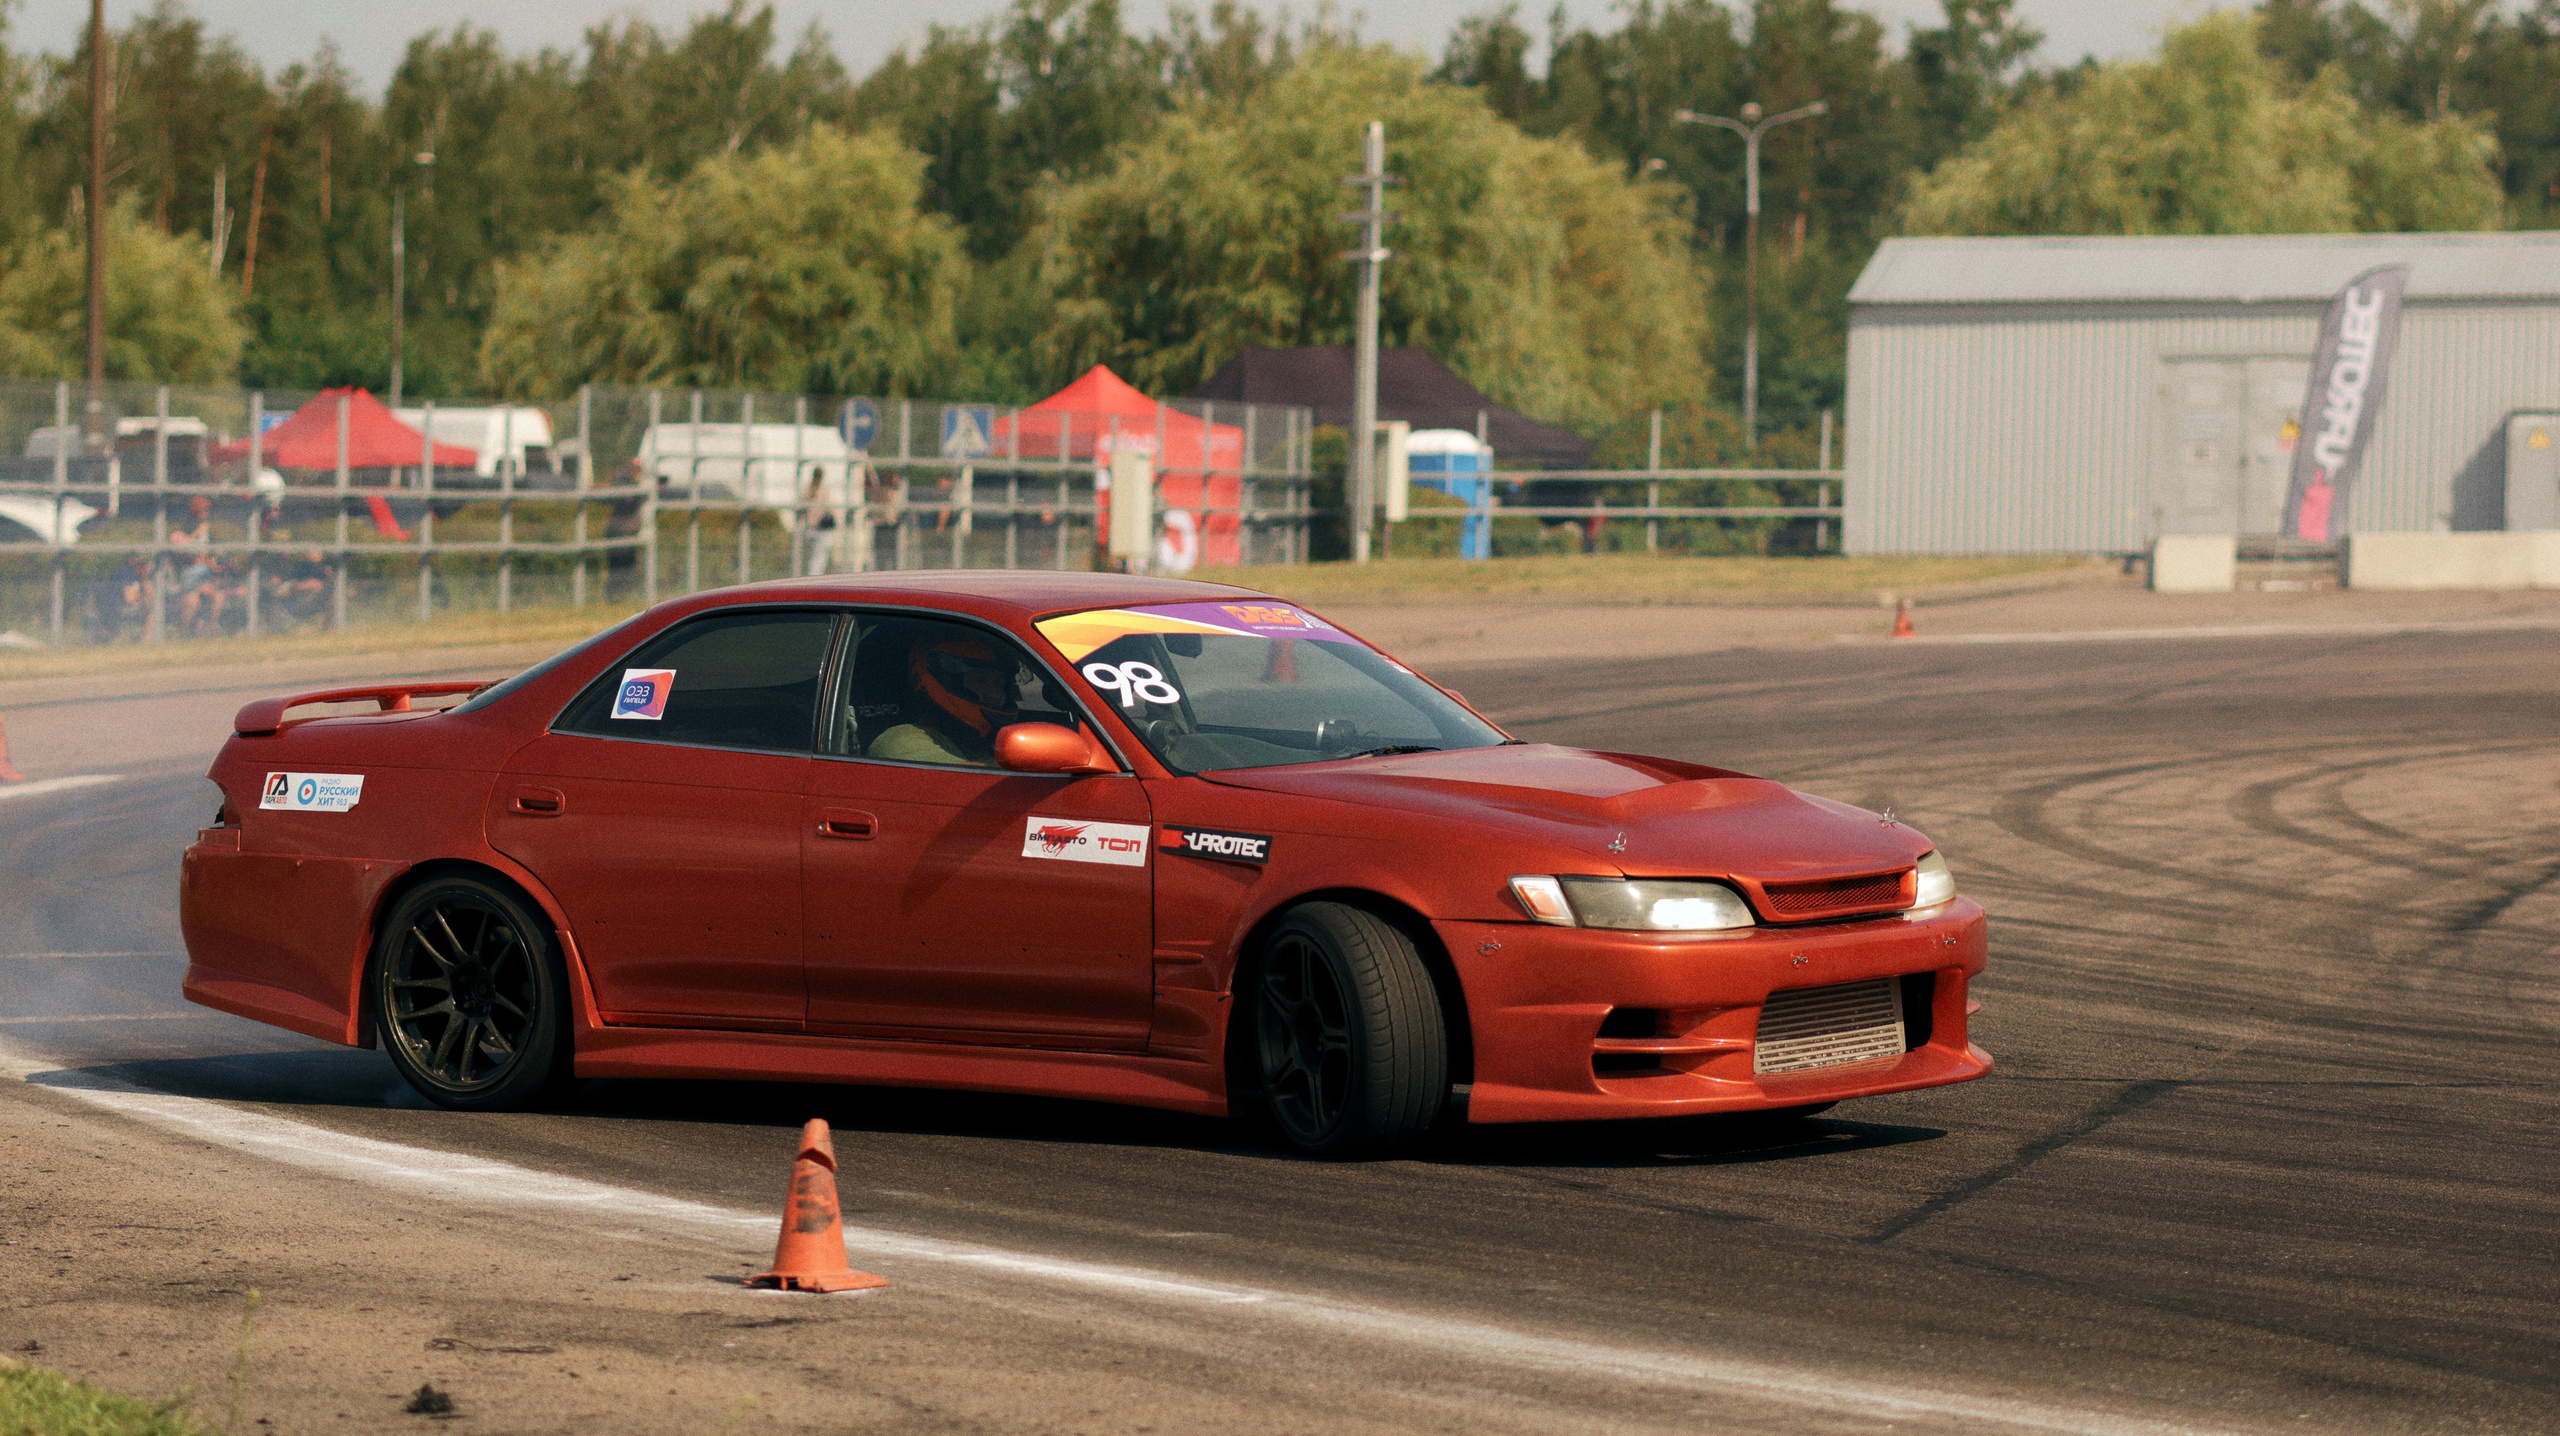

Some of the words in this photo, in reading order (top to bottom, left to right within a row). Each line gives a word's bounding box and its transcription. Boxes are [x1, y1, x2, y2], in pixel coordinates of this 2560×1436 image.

[1082, 661, 1181, 708] 98
[319, 786, 359, 797] РУССКИЙ
[316, 797, 335, 807] ХИТ
